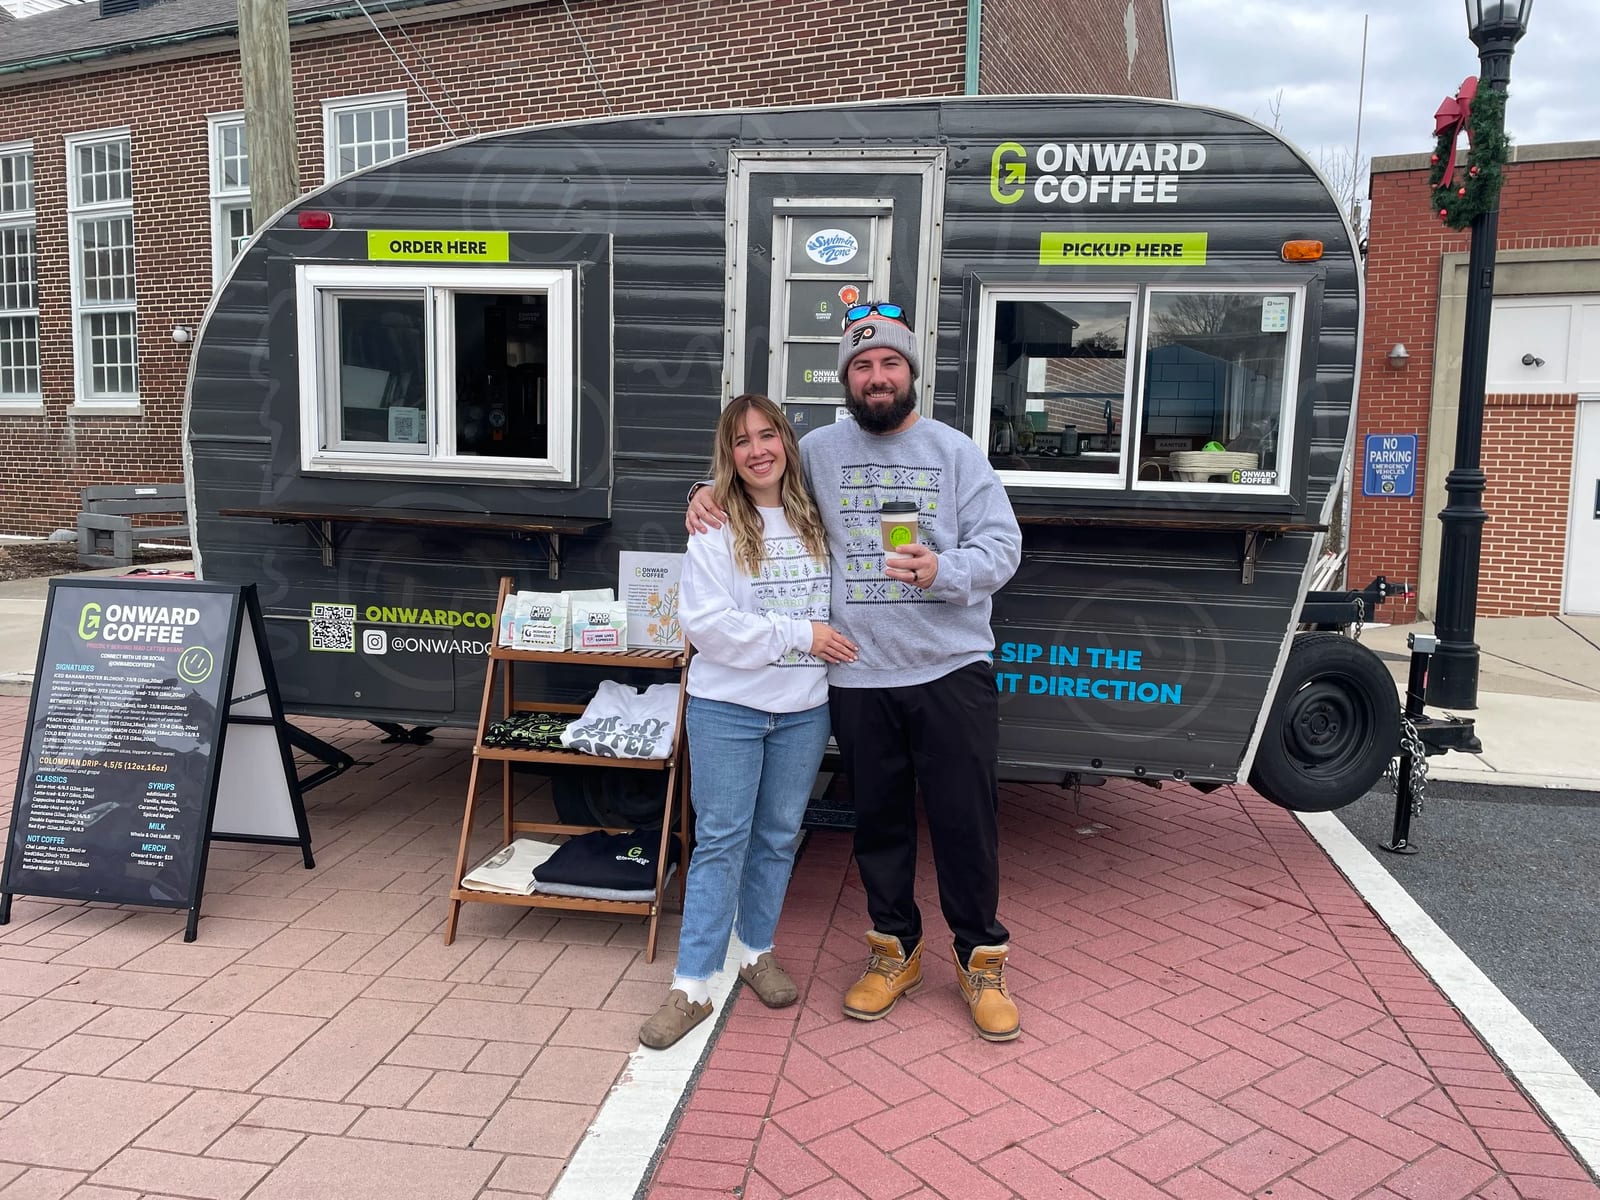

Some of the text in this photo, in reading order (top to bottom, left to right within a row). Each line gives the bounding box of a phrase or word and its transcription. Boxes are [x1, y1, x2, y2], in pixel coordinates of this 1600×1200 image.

[1036, 143, 1207, 172] ONWARD
[1034, 175, 1179, 203] COFFEE
[390, 241, 487, 254] ORDER HERE
[1063, 242, 1183, 257] PICKUP HERE
[823, 246, 851, 263] Zone
[1383, 438, 1398, 449] NO
[1370, 451, 1411, 463] PARKING
[105, 604, 200, 625] ONWARD
[531, 606, 552, 614] MAD
[589, 612, 610, 620] MAD
[102, 623, 184, 644] COFFEE
[1001, 642, 1043, 663] SIP
[1050, 645, 1080, 666] IN
[1087, 647, 1142, 671] THE
[56, 663, 95, 672] SIGNATURES
[1029, 674, 1182, 704] DIRECTION
[39, 757, 167, 773] COLOMBIAN DRIP- 4.5/5 (12oz,16oz)
[36, 775, 68, 784] CLASSICS
[148, 782, 175, 791] SYRUPS
[148, 822, 165, 830] MILK
[40, 836, 65, 845] COFFEE
[141, 843, 167, 852] MERCH
